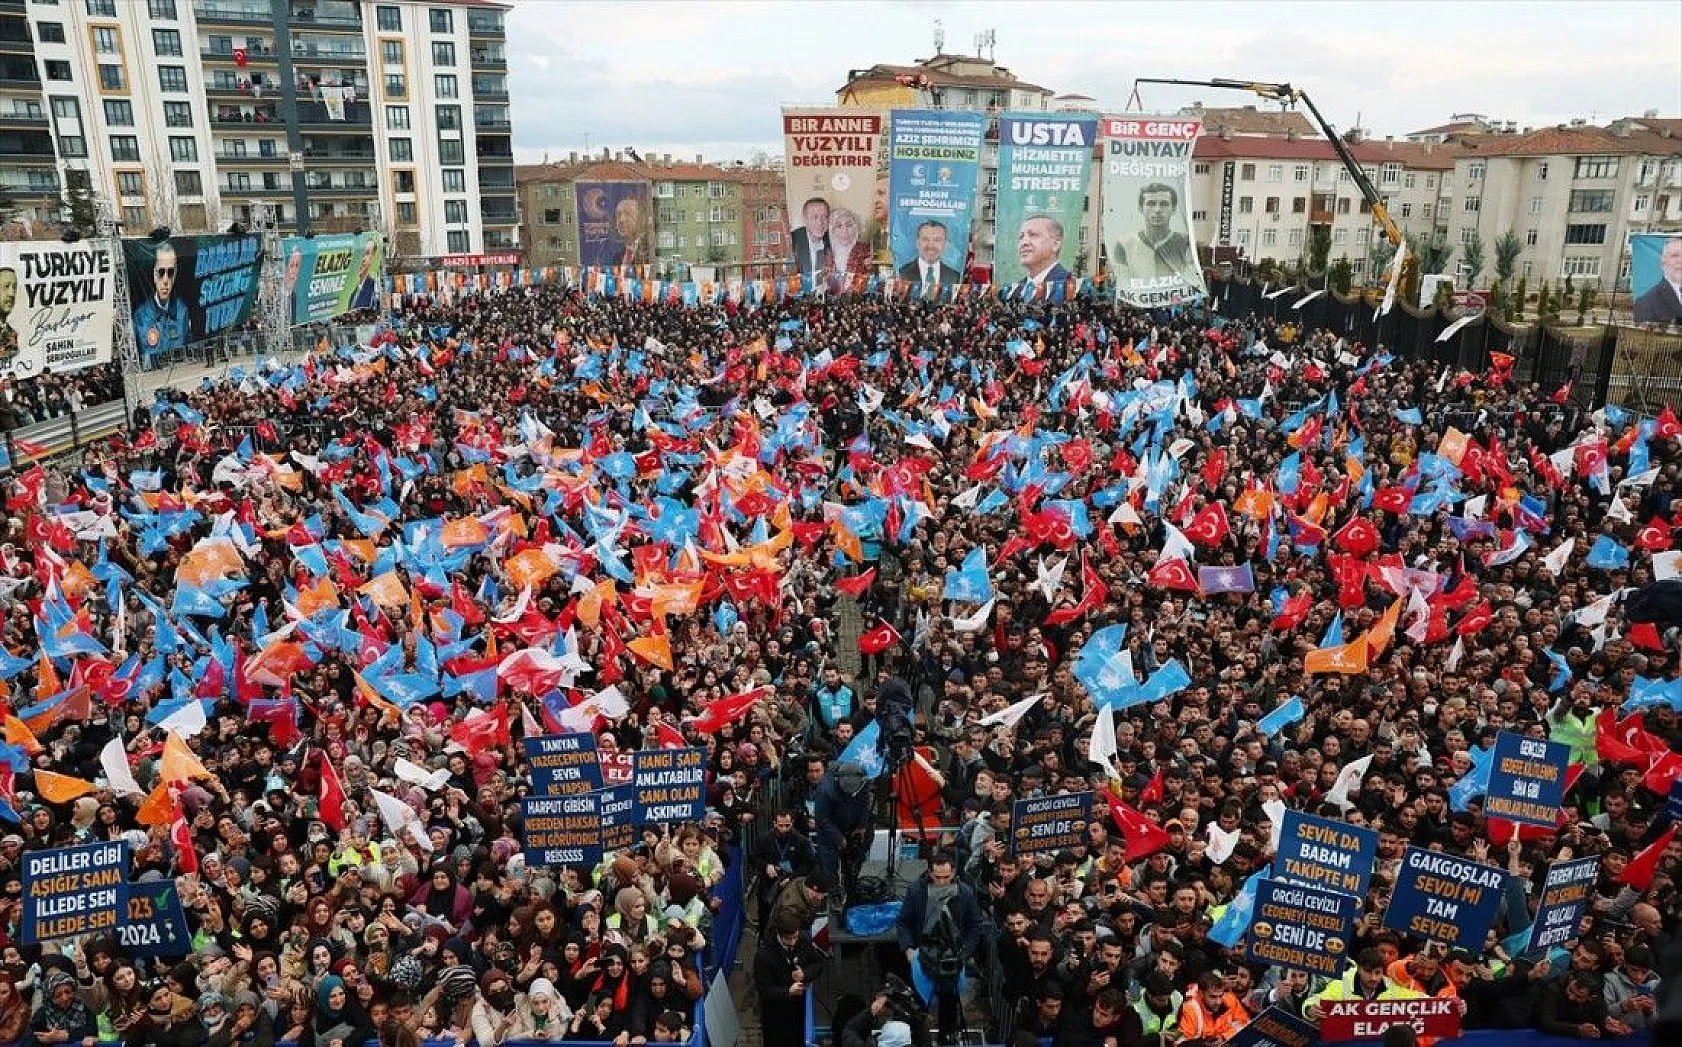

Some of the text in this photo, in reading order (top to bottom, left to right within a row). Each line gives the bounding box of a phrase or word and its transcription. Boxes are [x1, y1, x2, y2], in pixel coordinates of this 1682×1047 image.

[821, 118, 873, 132] ANNE
[1011, 122, 1086, 146] USTA
[1145, 122, 1194, 140] GENÇ
[1012, 147, 1083, 162] HİZMETTE
[541, 739, 579, 752] TANIYAN
[552, 768, 580, 780] SEVEN
[636, 768, 702, 787] ANLATABİLİR
[639, 786, 698, 804] SANA OLAN
[528, 801, 562, 815] HARPUT
[646, 804, 692, 821] AŞKIMIZI
[1057, 820, 1071, 834] DE
[1297, 823, 1360, 852] SEVİK DA
[30, 844, 122, 876] DELİLER GİBİ
[1300, 844, 1352, 868] BABAM
[1284, 858, 1341, 886] TAKİPTE
[1410, 852, 1502, 889] GAKGOŞLAR
[31, 868, 122, 897] AŞIĞIZ SANA
[1415, 876, 1462, 900] SEVDİ
[36, 889, 116, 918] İLLEDE SEN
[1426, 898, 1459, 920] TAM
[89, 909, 116, 929] SEN
[1411, 916, 1460, 941] SEVER
[116, 923, 160, 946] 2024
[1306, 930, 1326, 950] DE
[1330, 1000, 1452, 1019] AK GENÇLİK
